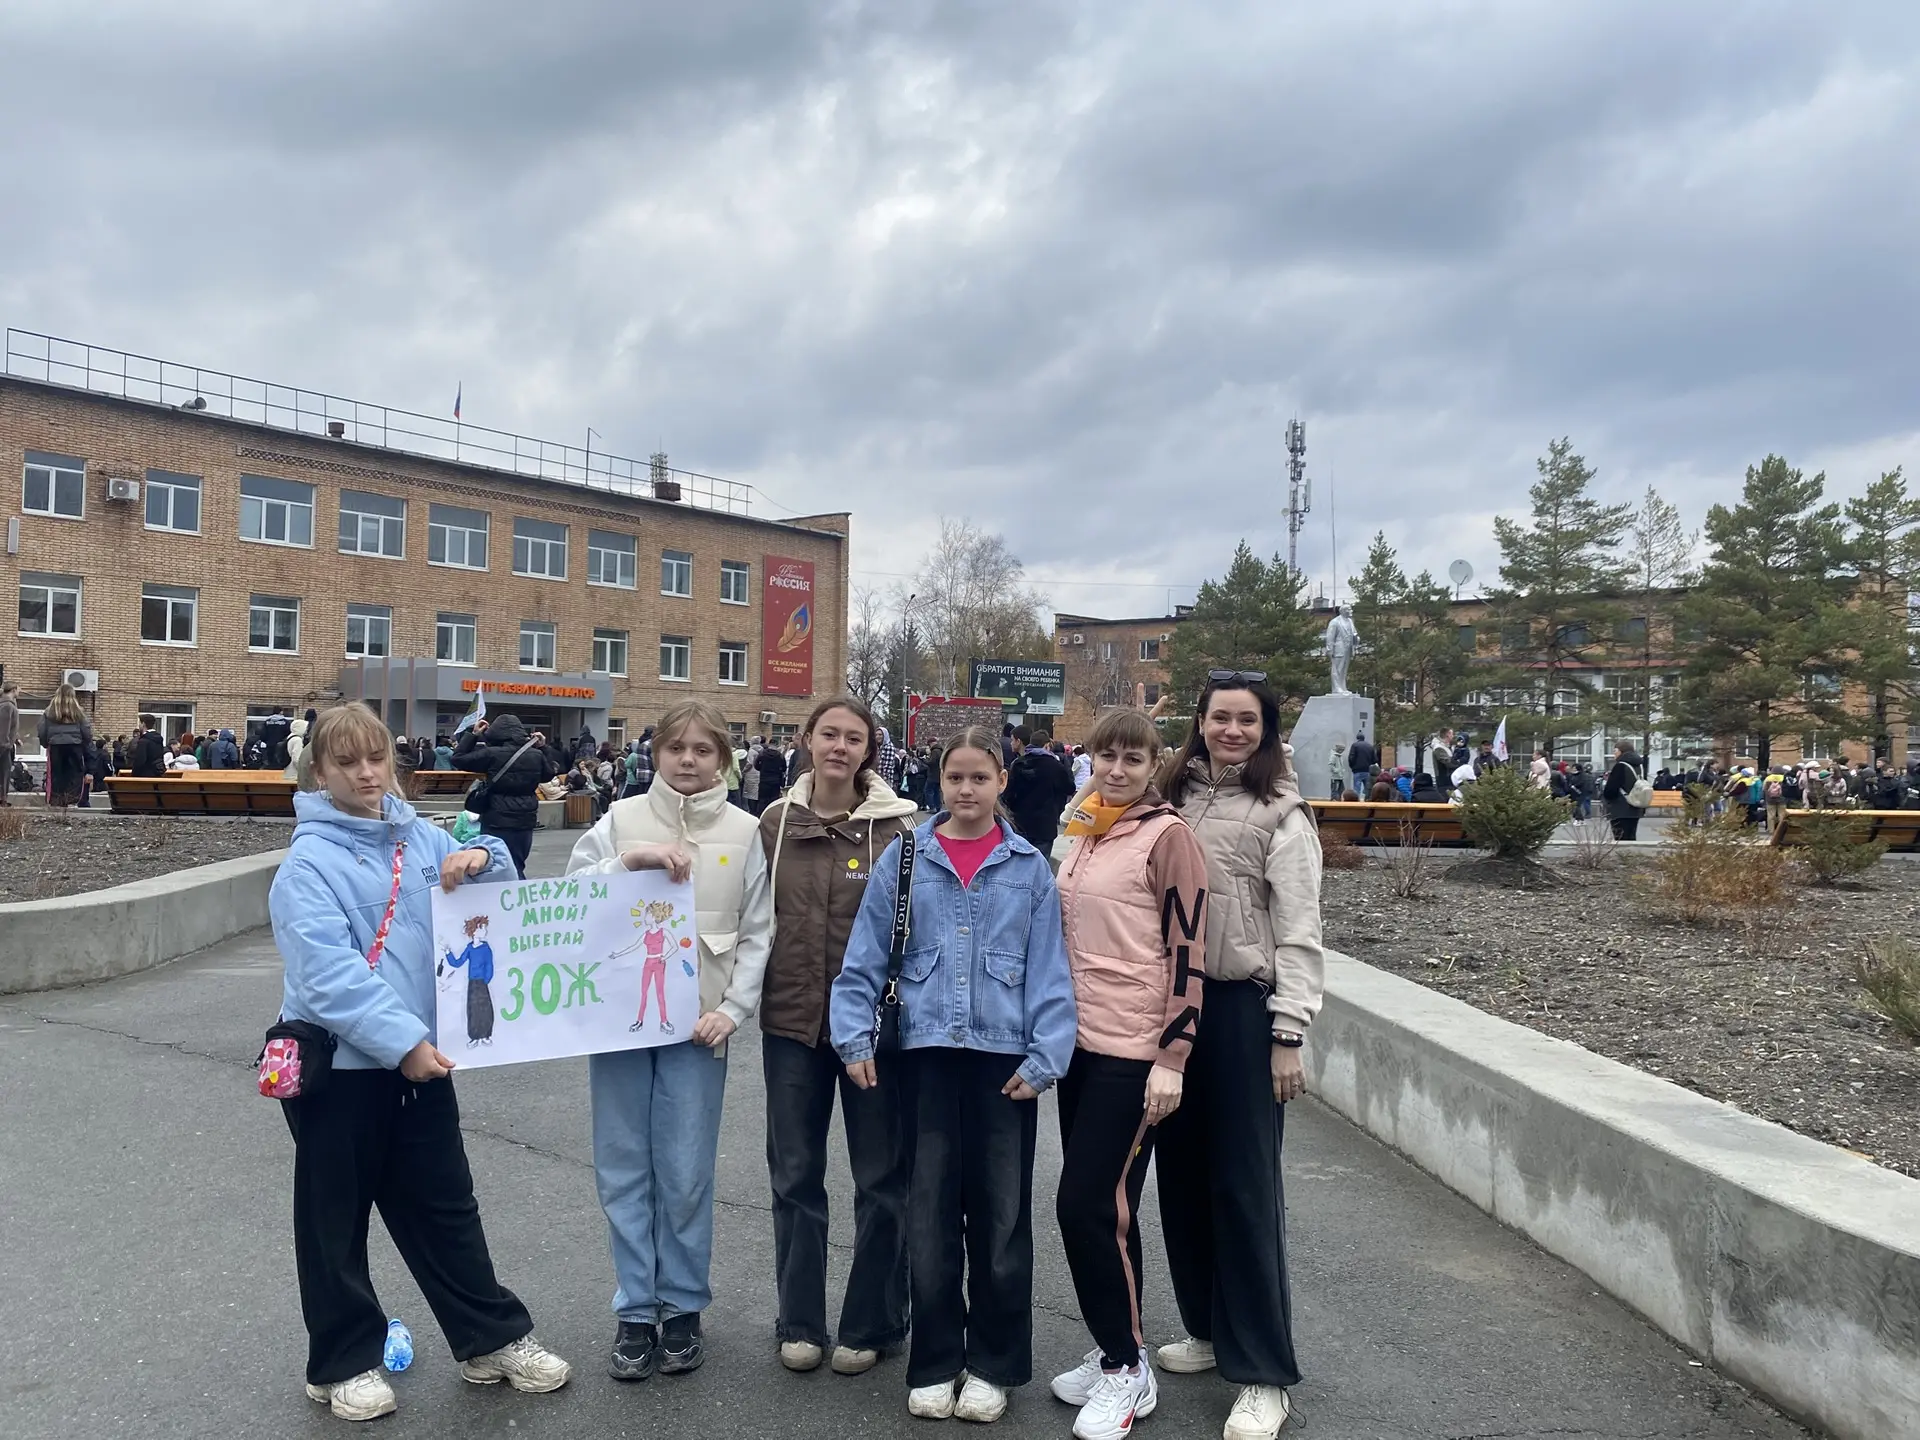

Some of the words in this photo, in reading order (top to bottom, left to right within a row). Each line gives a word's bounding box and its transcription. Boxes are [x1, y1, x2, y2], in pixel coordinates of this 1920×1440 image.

[976, 664, 1015, 675] ОБРАТИТЕ
[1016, 666, 1061, 677] ВНИМАНИЕ
[497, 682, 547, 696] РАЗВИТИЯ
[902, 839, 912, 875] TOUS
[500, 878, 579, 911] СЛЕДУЙ
[589, 882, 608, 899] ЗА
[522, 904, 587, 927] МНОЙ!
[896, 894, 907, 932] TOUS
[509, 929, 584, 953] ВЫБЕРАЙ
